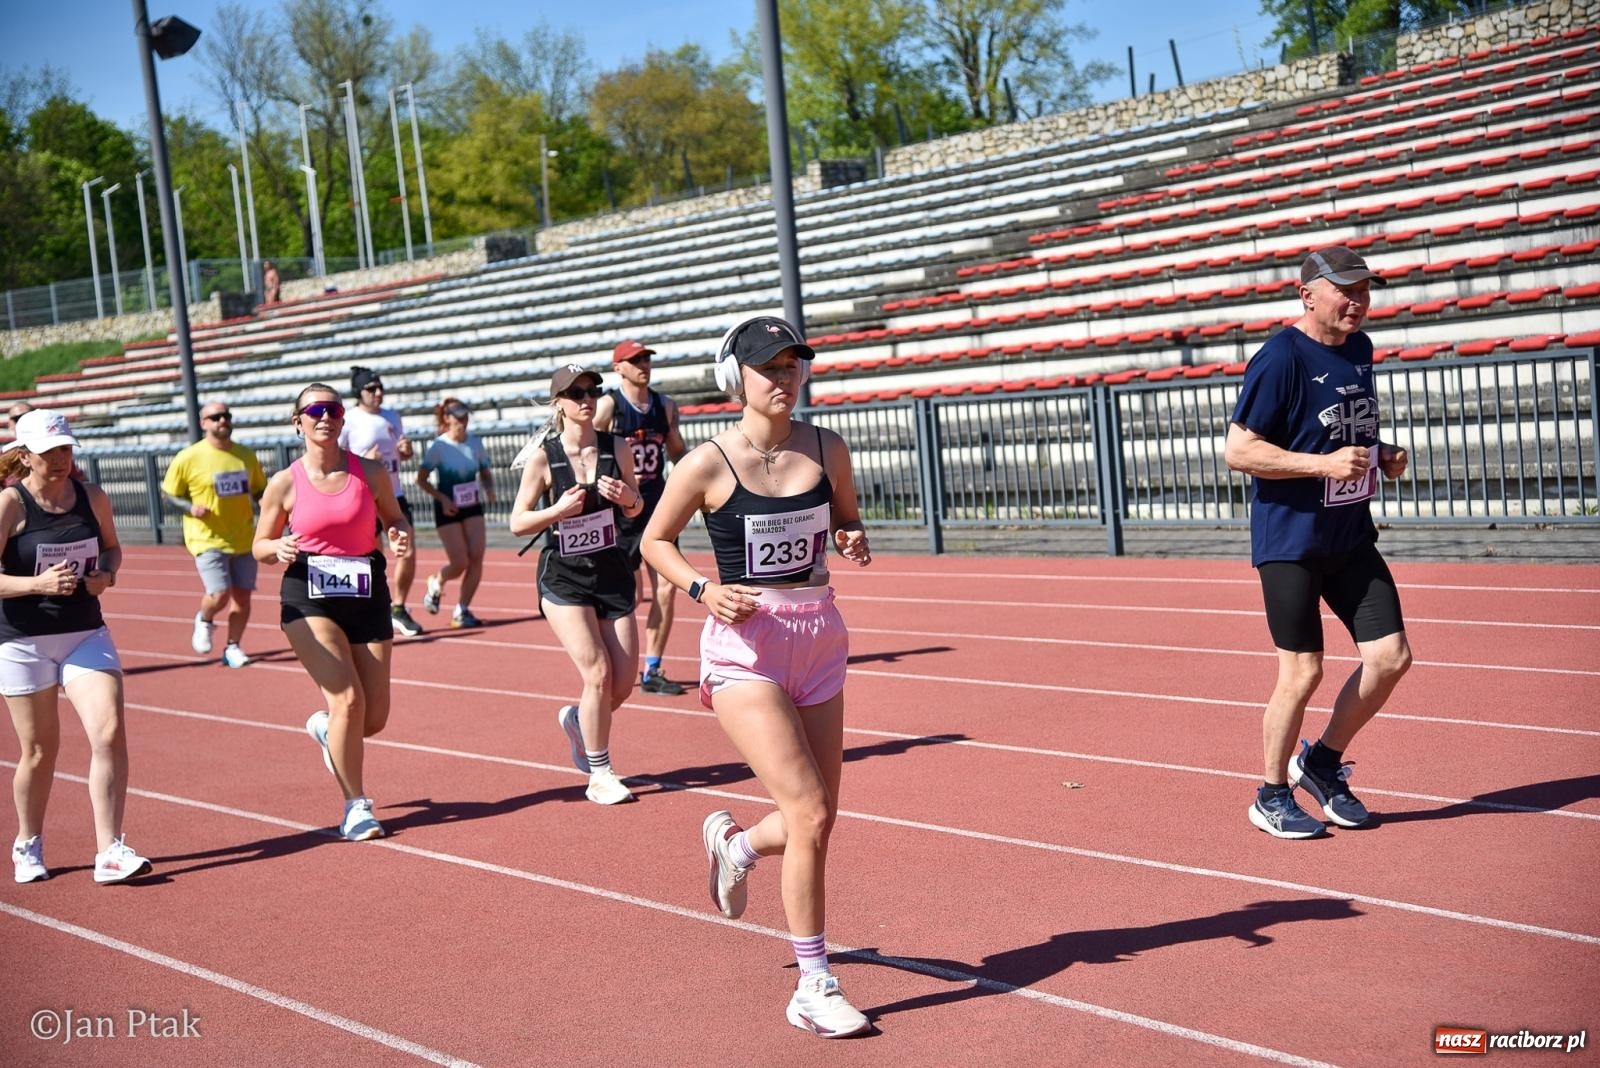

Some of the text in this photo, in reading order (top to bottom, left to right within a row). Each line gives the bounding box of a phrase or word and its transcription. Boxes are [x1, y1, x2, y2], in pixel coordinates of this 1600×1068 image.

[631, 443, 659, 473] 33
[782, 517, 794, 525] BEZ
[794, 513, 815, 523] GRANIC
[568, 530, 600, 549] 228
[759, 538, 808, 566] 233
[318, 573, 352, 589] 144
